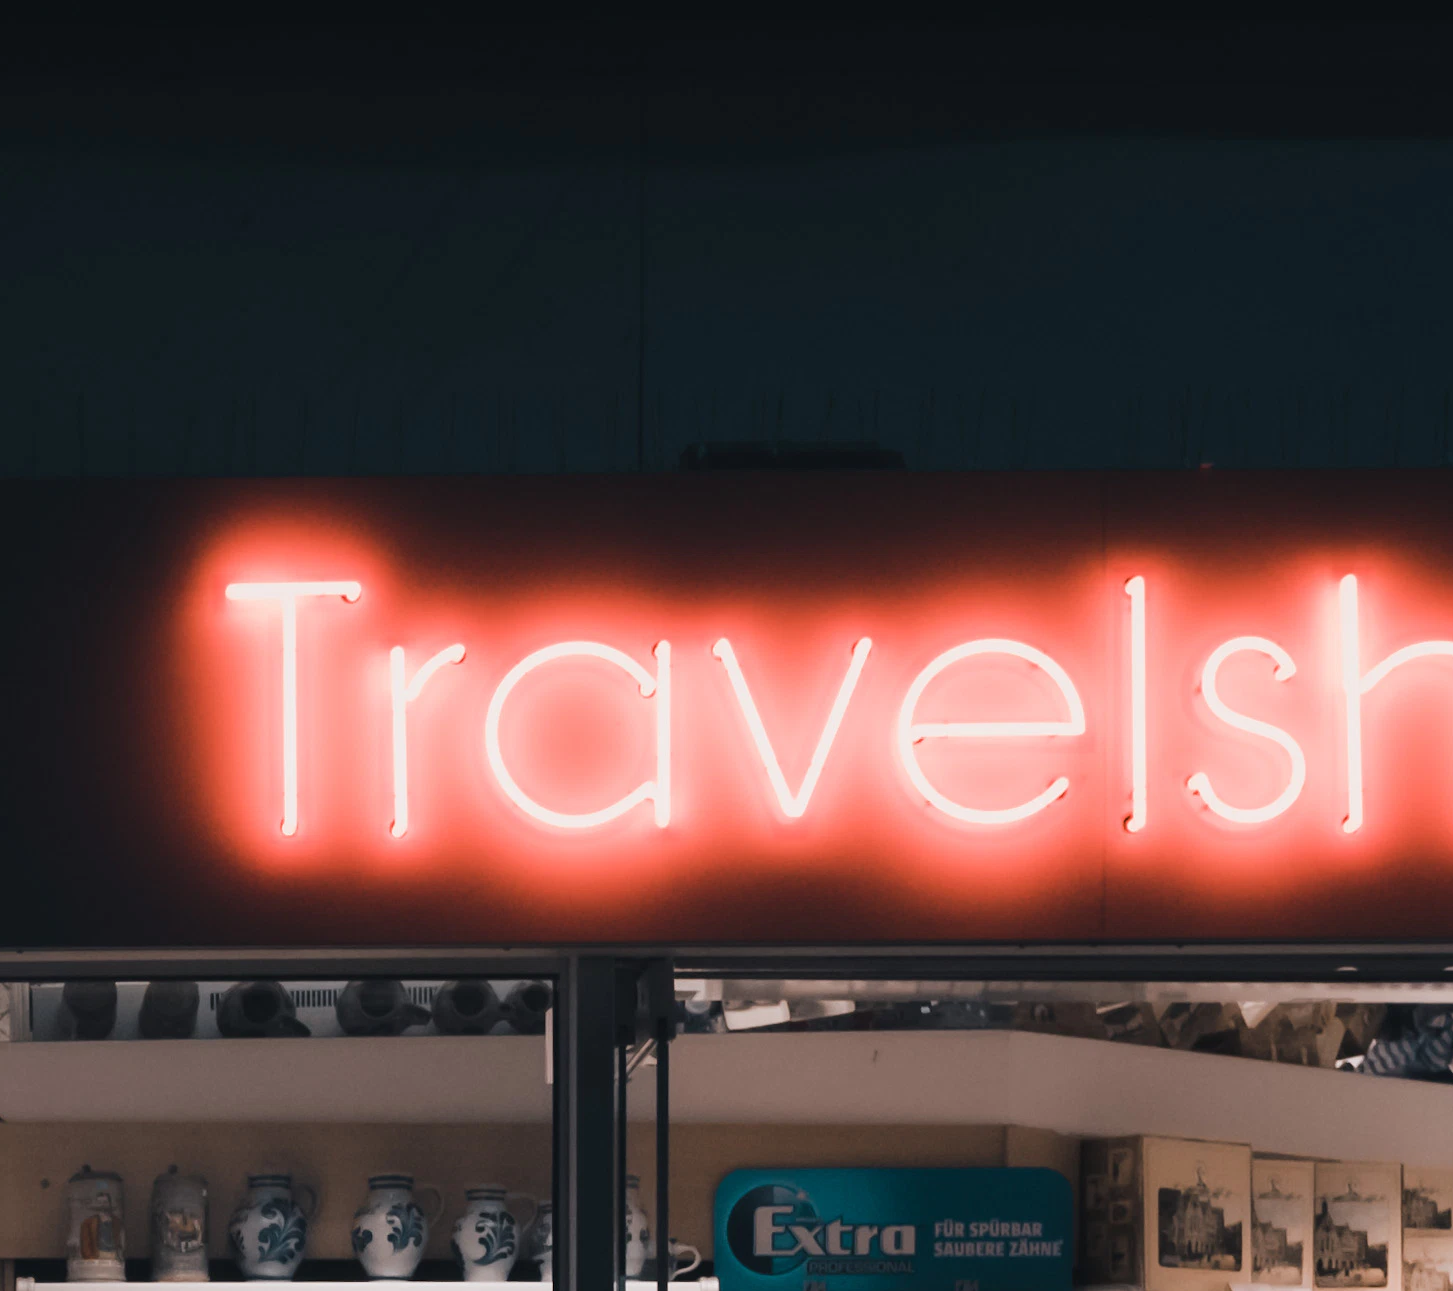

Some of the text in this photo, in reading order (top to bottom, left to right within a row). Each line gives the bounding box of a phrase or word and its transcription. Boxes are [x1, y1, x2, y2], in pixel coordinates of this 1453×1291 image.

[753, 1204, 916, 1257] Extra
[934, 1218, 1042, 1238] FÜR SPÜRBAR
[933, 1240, 1004, 1258] SAUBERE
[807, 1259, 915, 1275] PROFESSIONAL
